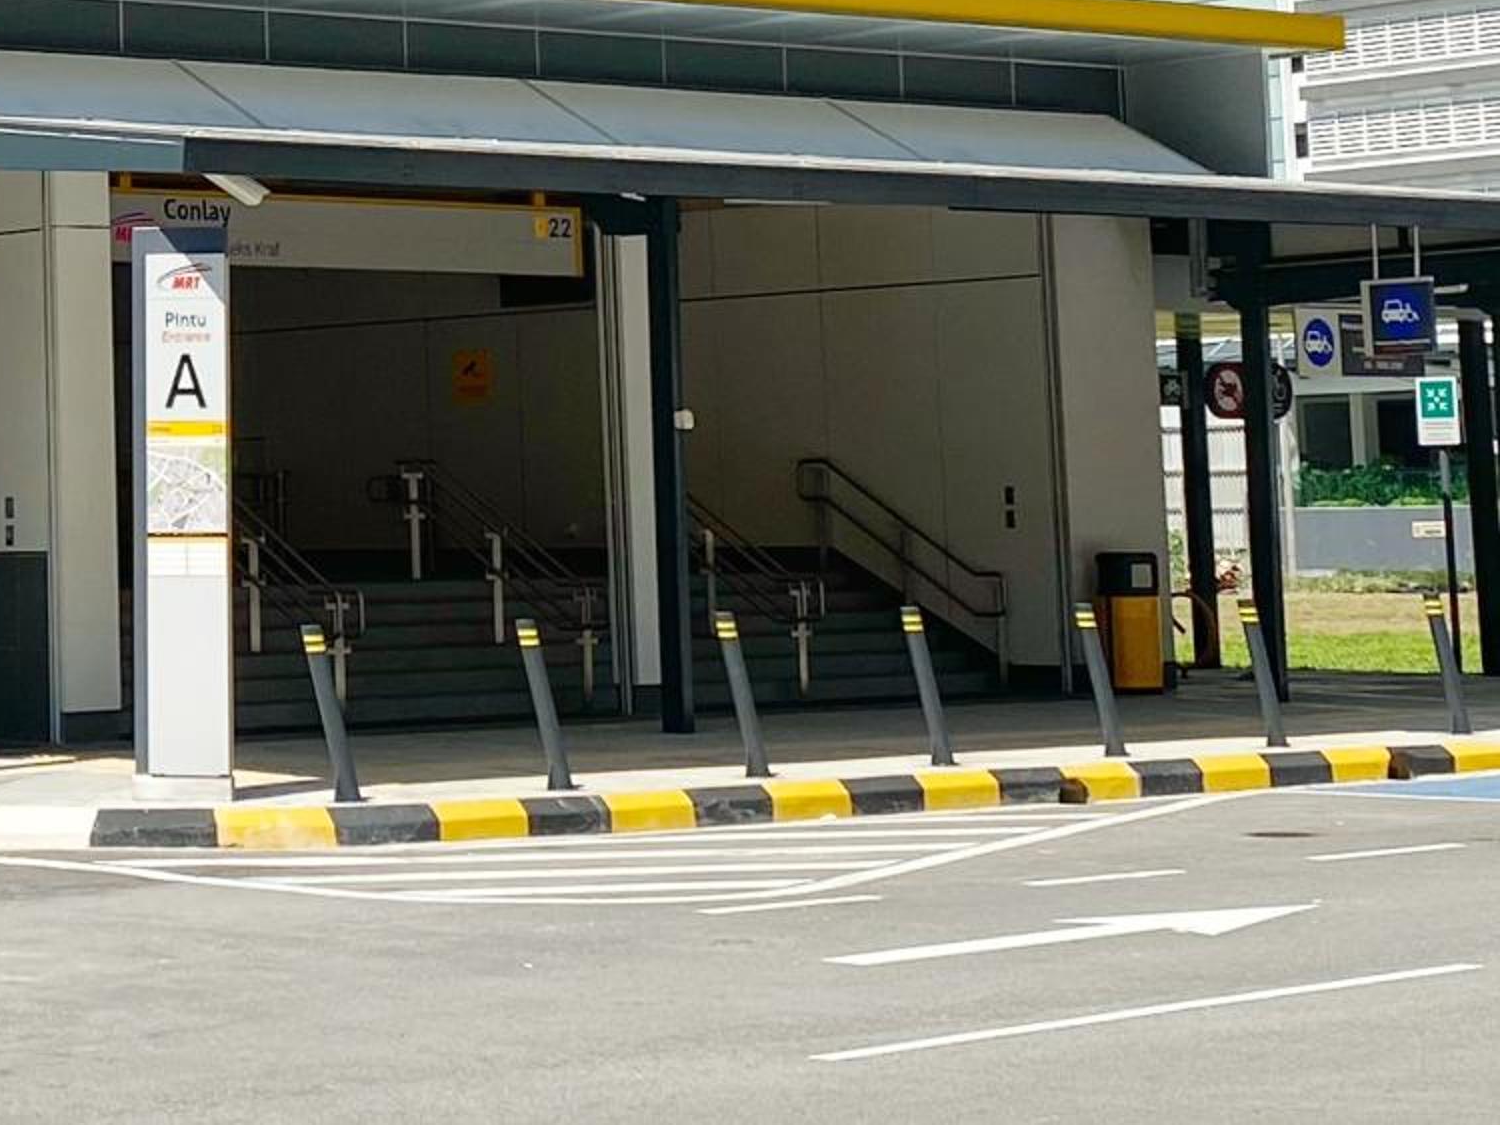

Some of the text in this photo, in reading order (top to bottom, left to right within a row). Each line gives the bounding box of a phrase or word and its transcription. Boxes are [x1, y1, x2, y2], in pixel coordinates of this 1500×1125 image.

[164, 198, 231, 227] Conlay
[548, 218, 572, 237] 22
[171, 276, 201, 290] MRT
[165, 312, 207, 327] Pintu
[165, 353, 207, 409] A
